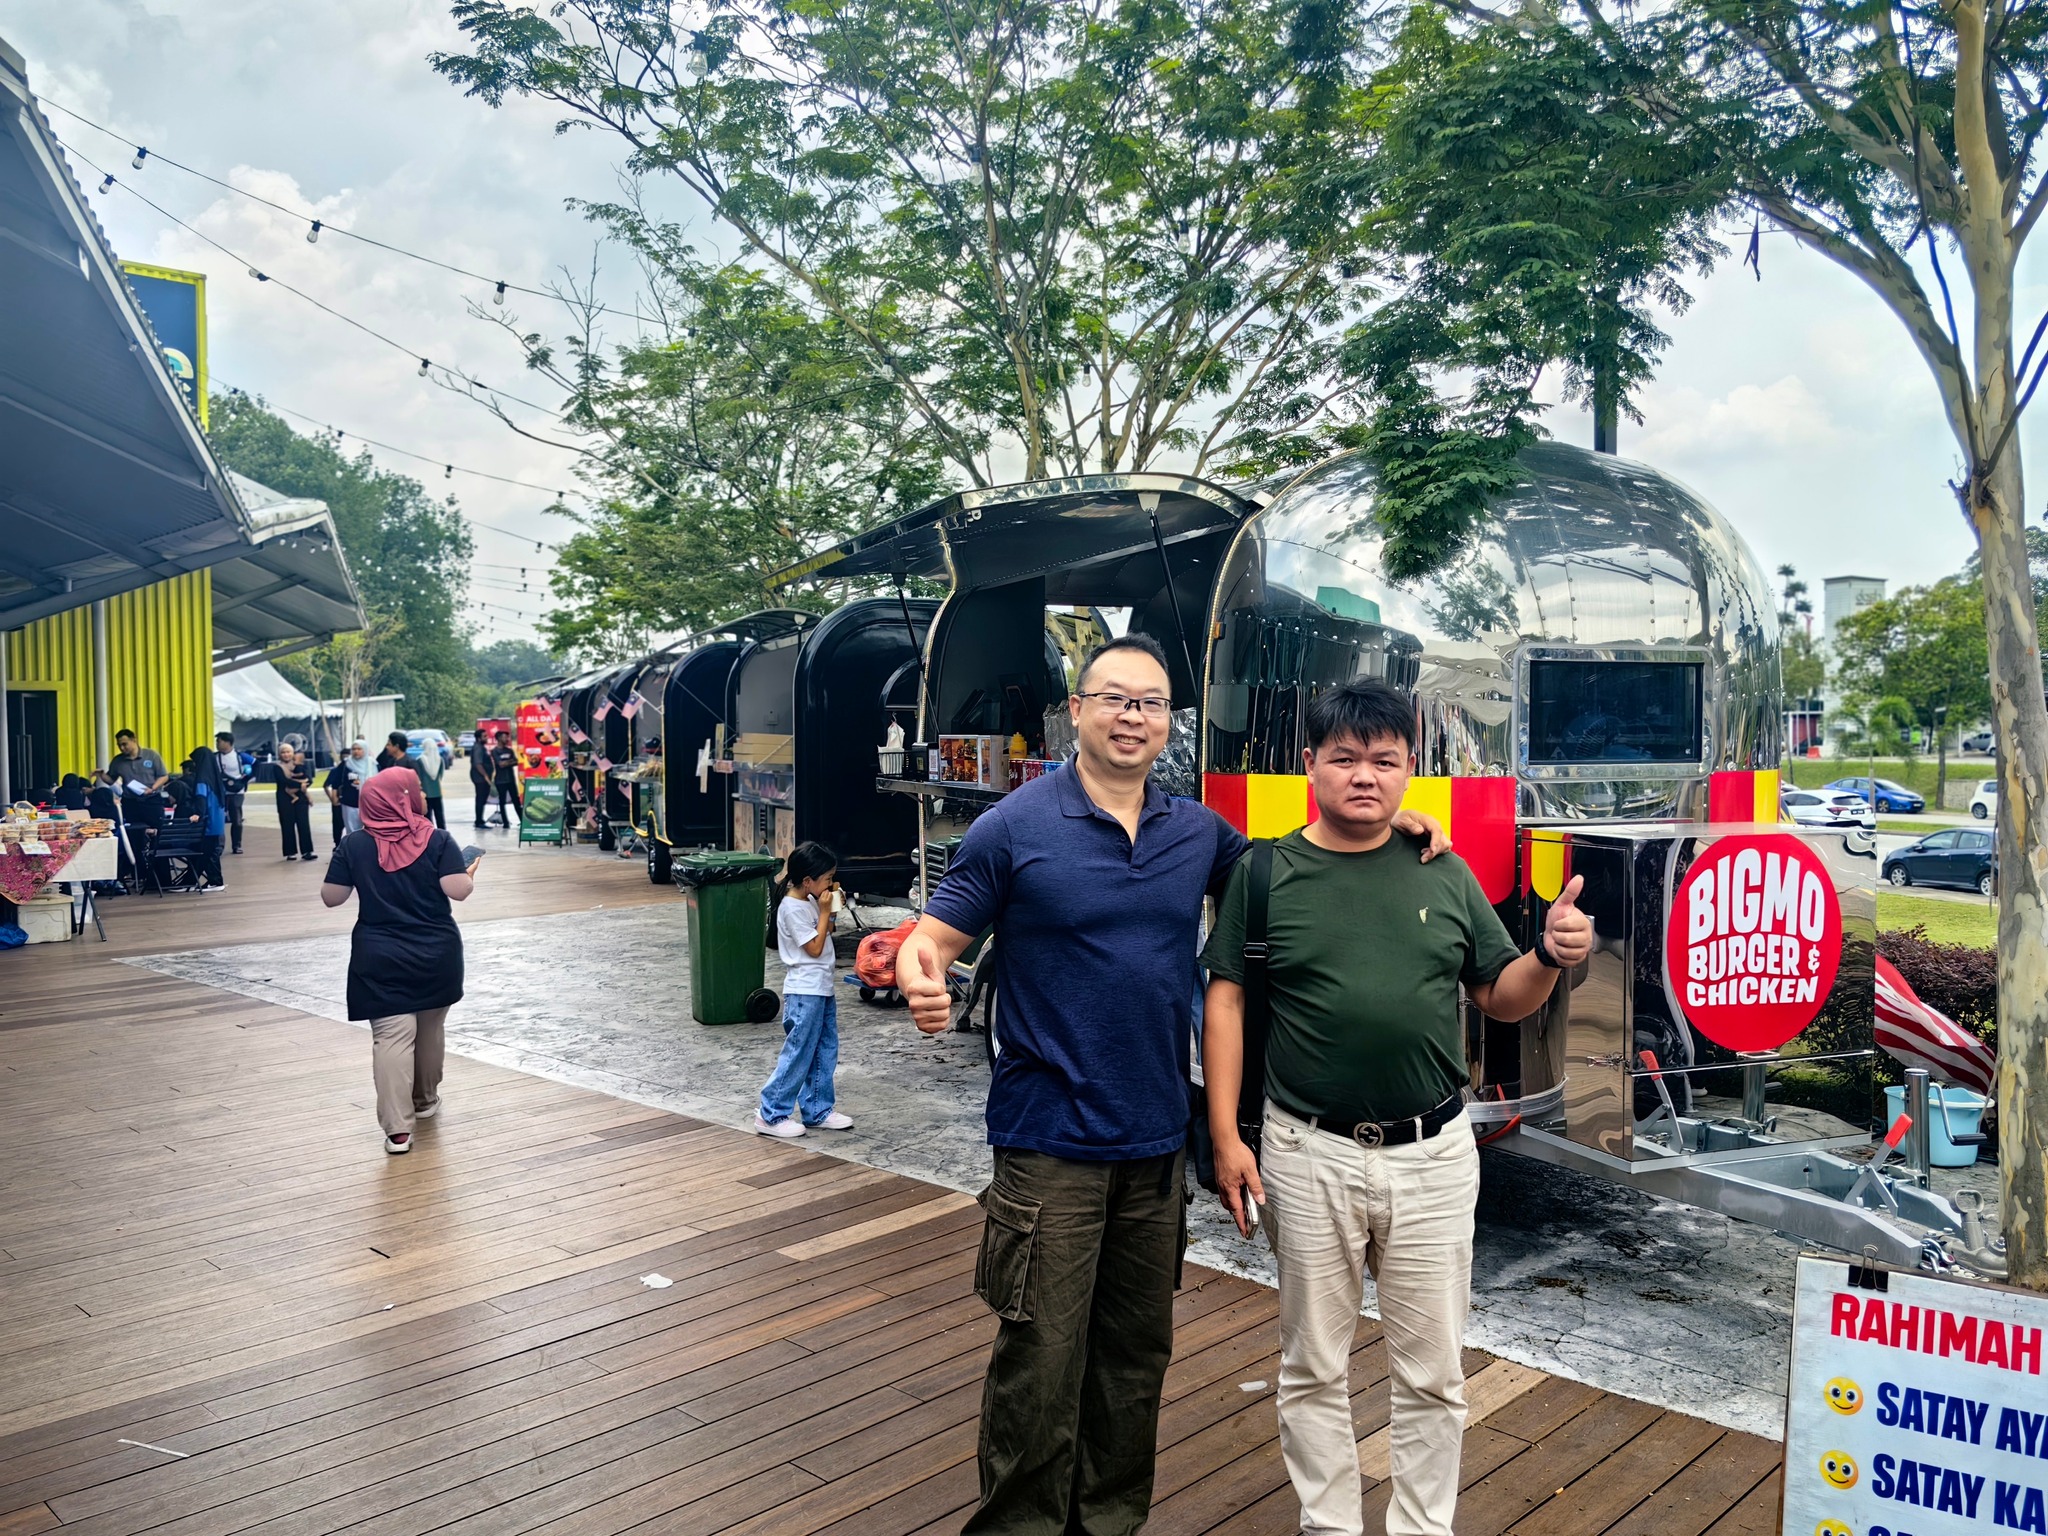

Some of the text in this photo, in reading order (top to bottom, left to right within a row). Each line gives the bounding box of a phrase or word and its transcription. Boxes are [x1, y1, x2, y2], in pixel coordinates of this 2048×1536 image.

[1688, 848, 1825, 945] BIGMO
[1688, 933, 1821, 981] BURGER &
[1686, 975, 1818, 1007] CHICKEN
[1830, 1292, 2042, 1376] RAHIMAH
[1876, 1381, 1990, 1446] SATAY
[1871, 1453, 1986, 1520] SATAY
